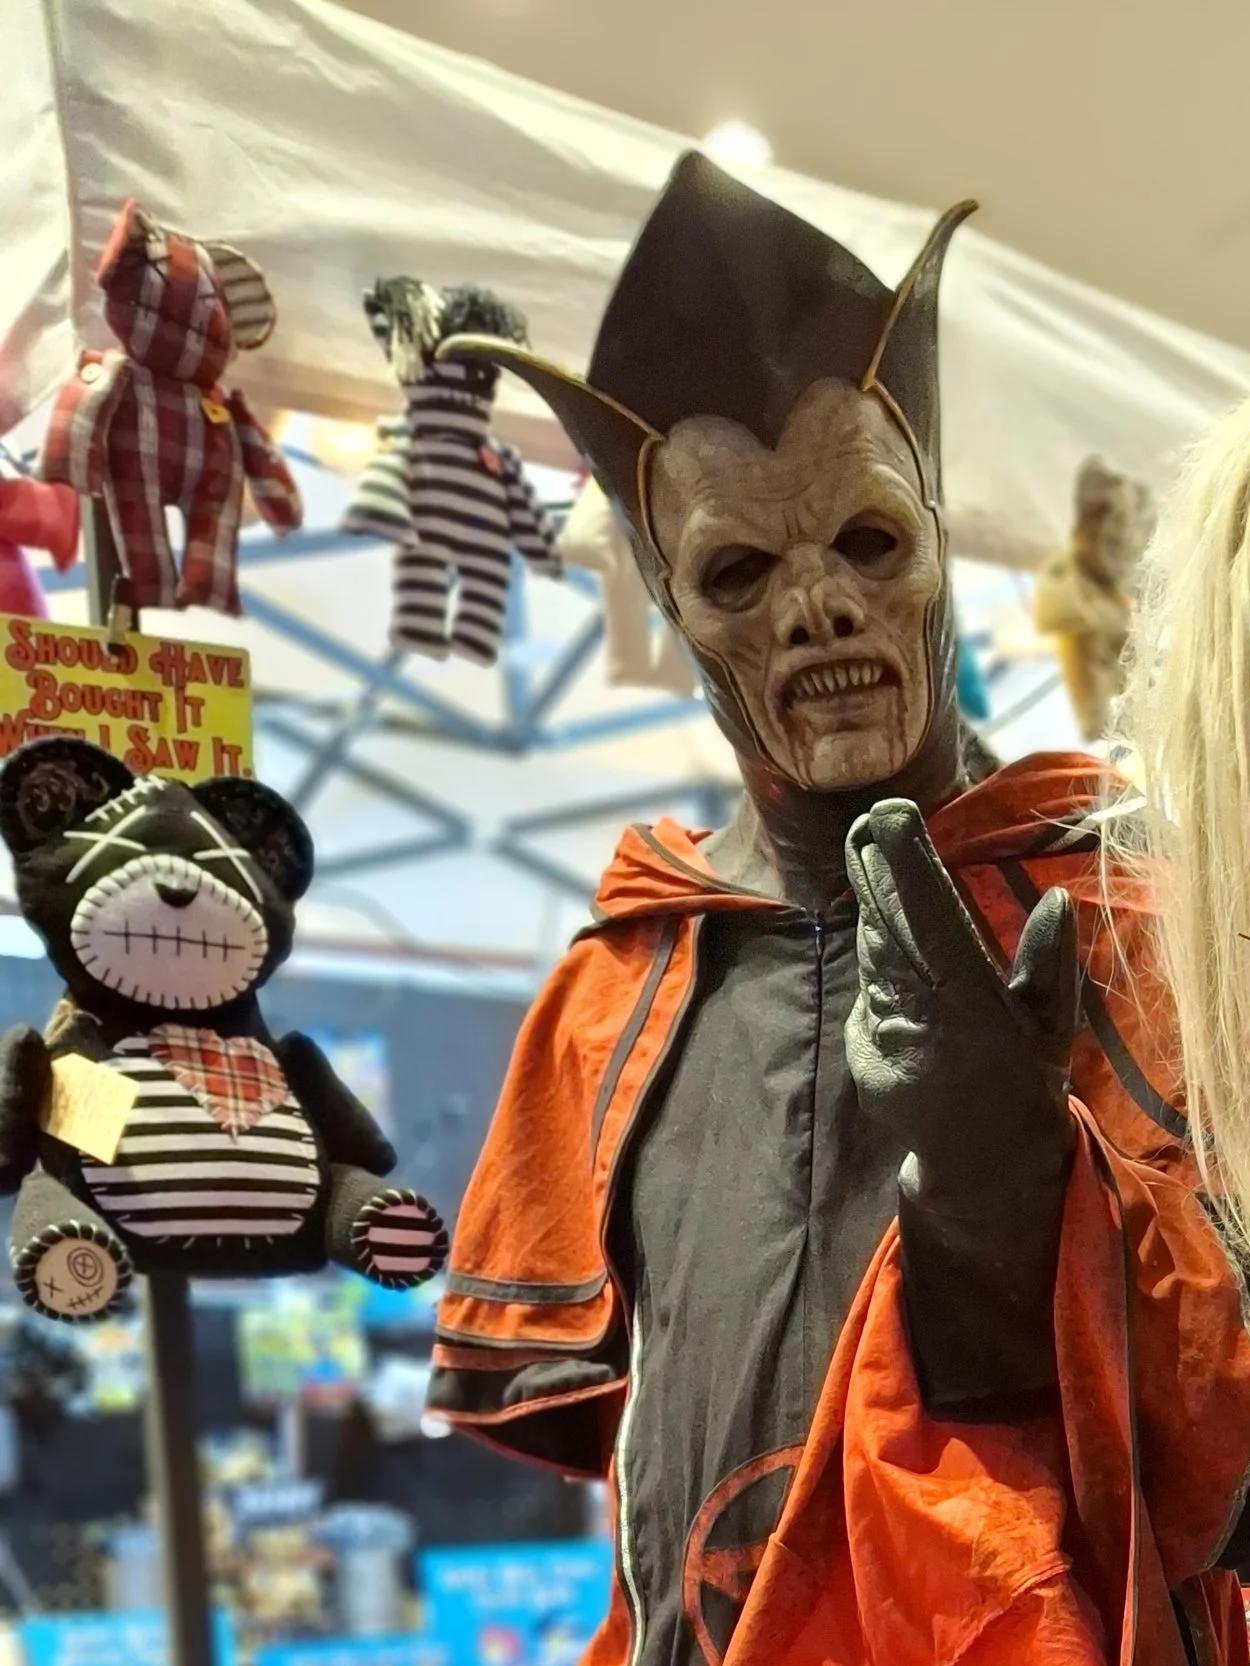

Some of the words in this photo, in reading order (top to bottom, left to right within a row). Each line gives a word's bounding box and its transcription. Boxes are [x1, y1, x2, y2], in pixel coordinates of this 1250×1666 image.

[149, 641, 244, 688] HAVE
[25, 670, 162, 722] BOUGHT
[175, 686, 205, 734] IT
[123, 724, 200, 774] SAW
